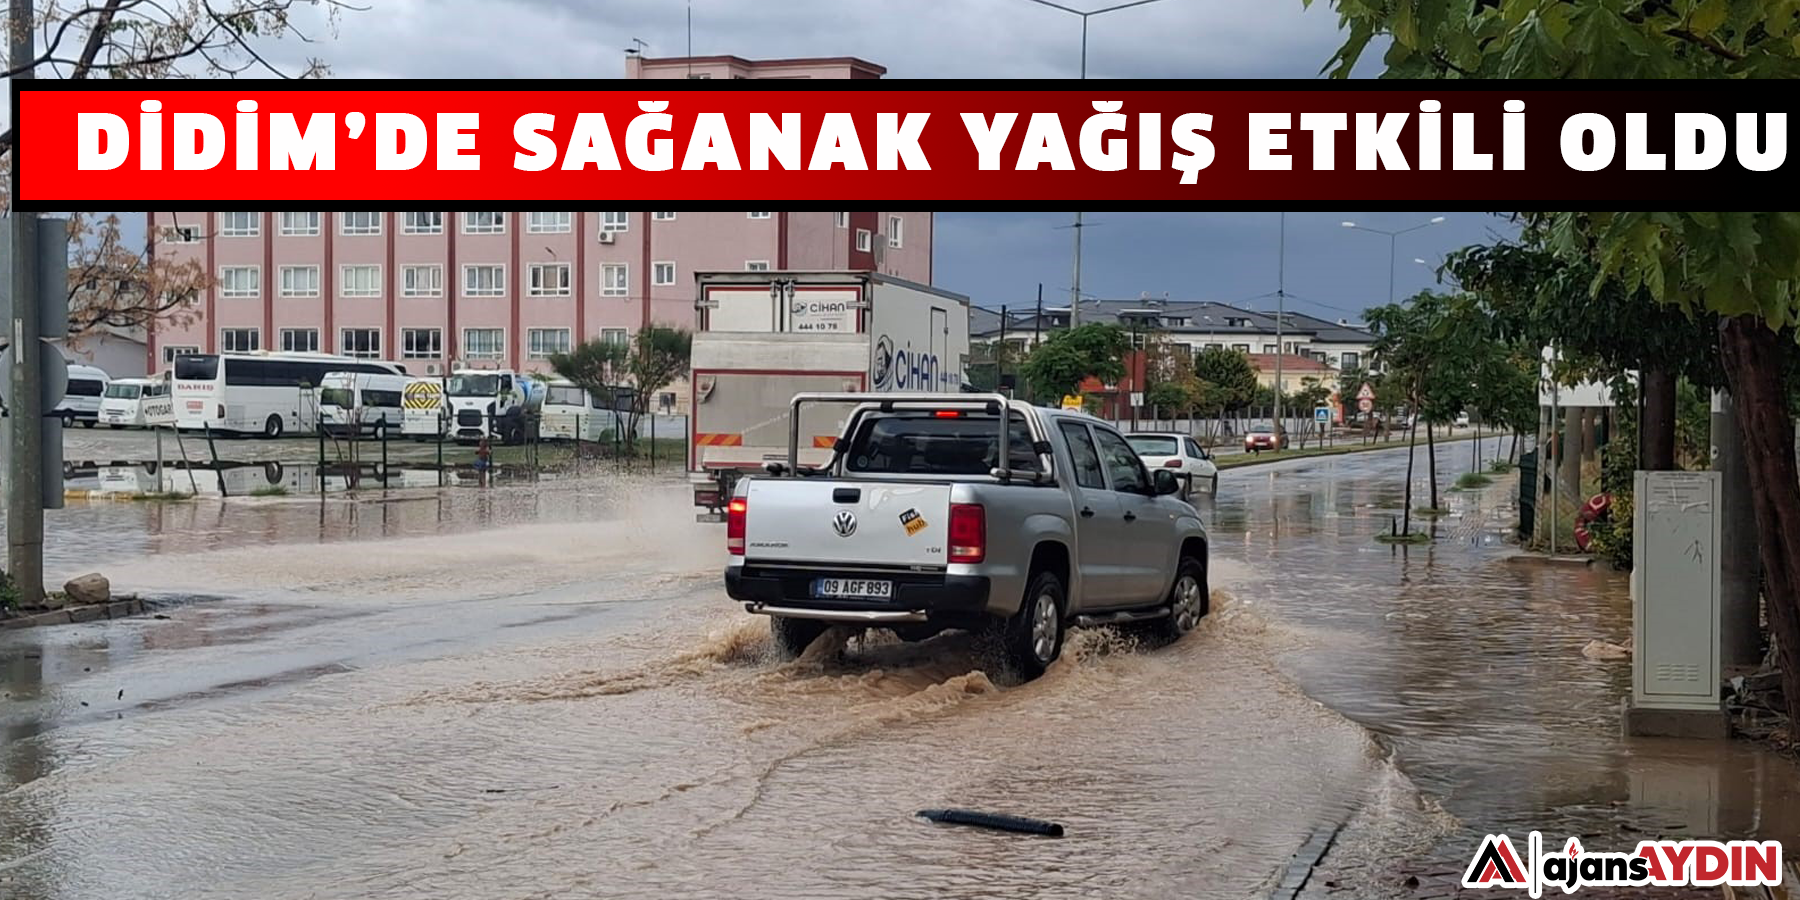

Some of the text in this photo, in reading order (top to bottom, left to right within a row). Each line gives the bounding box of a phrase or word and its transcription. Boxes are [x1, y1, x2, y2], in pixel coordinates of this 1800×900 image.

[824, 580, 890, 595] 09 AGF 893
